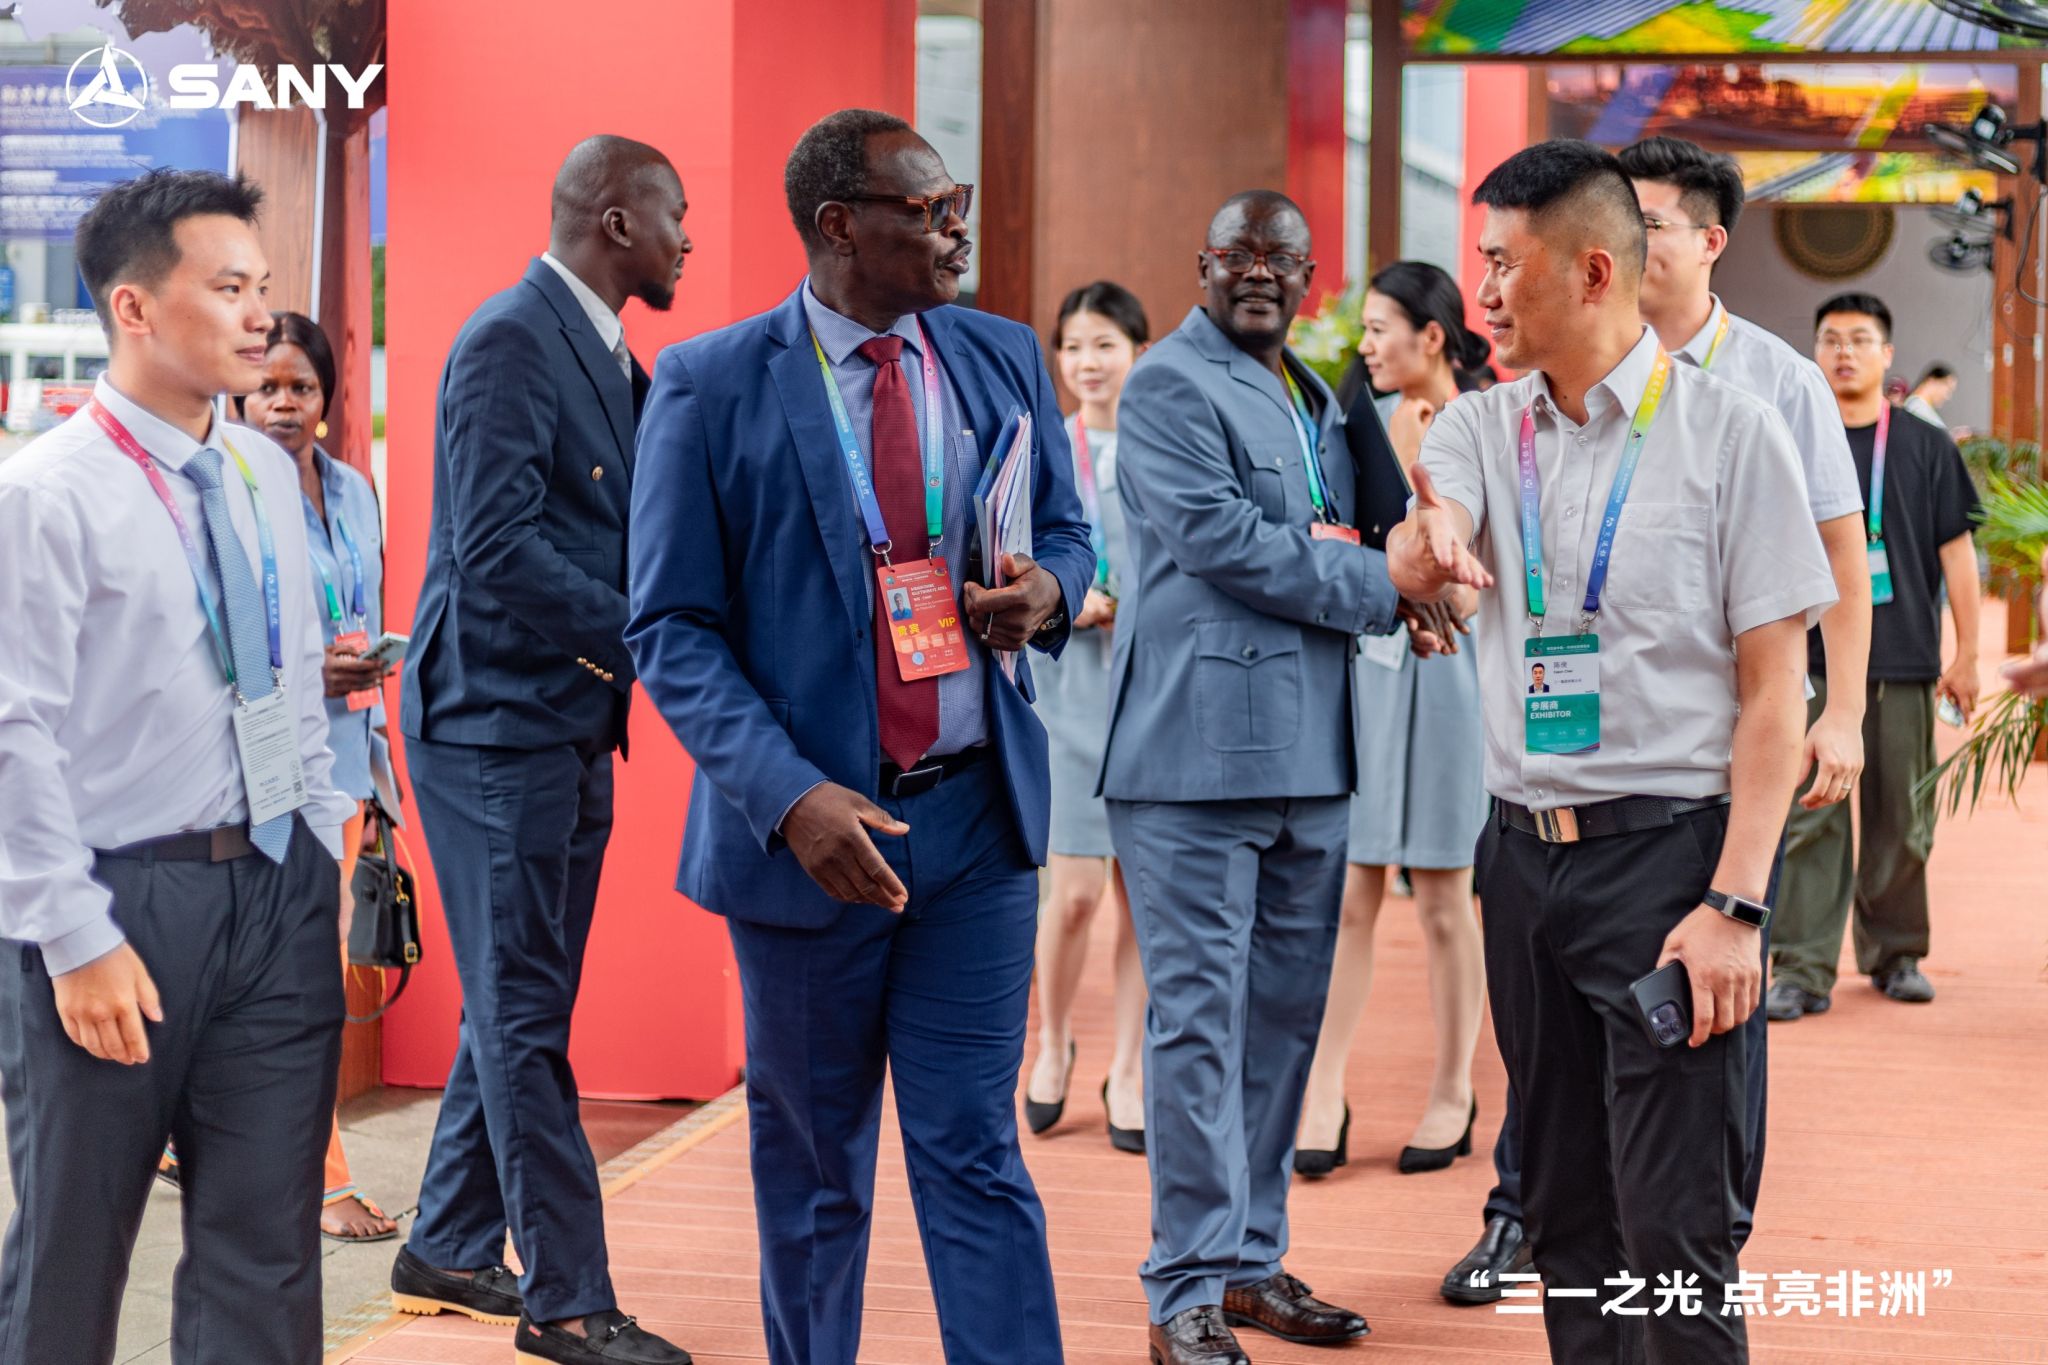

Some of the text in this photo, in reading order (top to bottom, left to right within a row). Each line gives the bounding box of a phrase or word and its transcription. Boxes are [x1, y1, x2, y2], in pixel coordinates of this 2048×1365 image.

[938, 616, 956, 628] VIP
[1530, 700, 1559, 711] 参展商
[1530, 710, 1572, 719] EXHIBITOR
